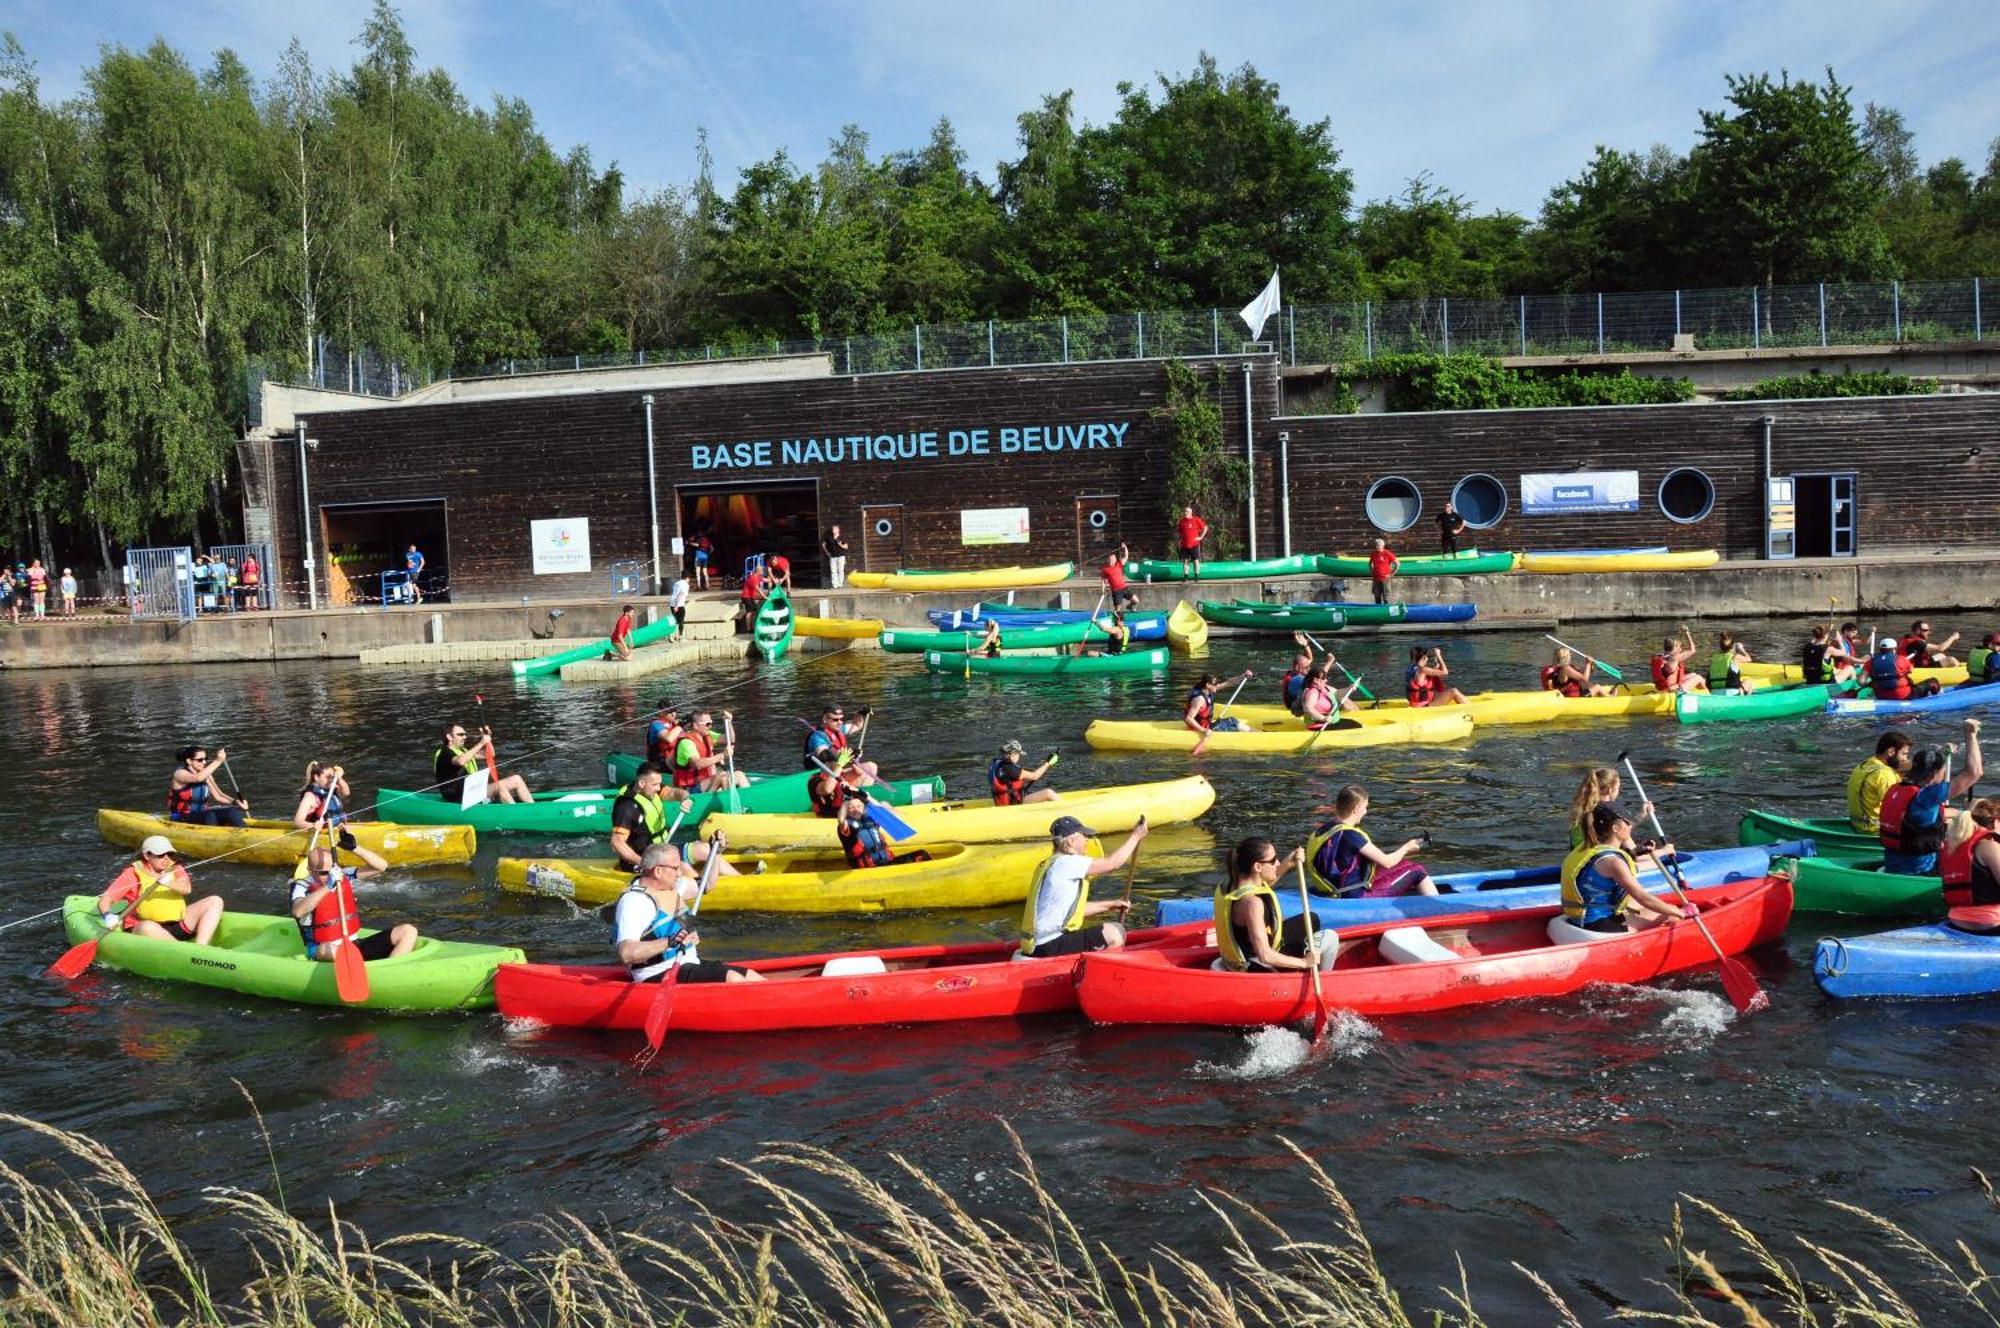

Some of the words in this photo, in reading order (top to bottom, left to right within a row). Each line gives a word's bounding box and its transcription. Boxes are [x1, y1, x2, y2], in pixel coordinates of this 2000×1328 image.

[691, 442, 772, 469] BASE
[781, 432, 938, 465] NAUTIQUE
[948, 429, 990, 456] DE
[1000, 422, 1129, 453] BEUVRY
[1556, 490, 1590, 498] facebook
[191, 957, 237, 970] ROTOMOD
